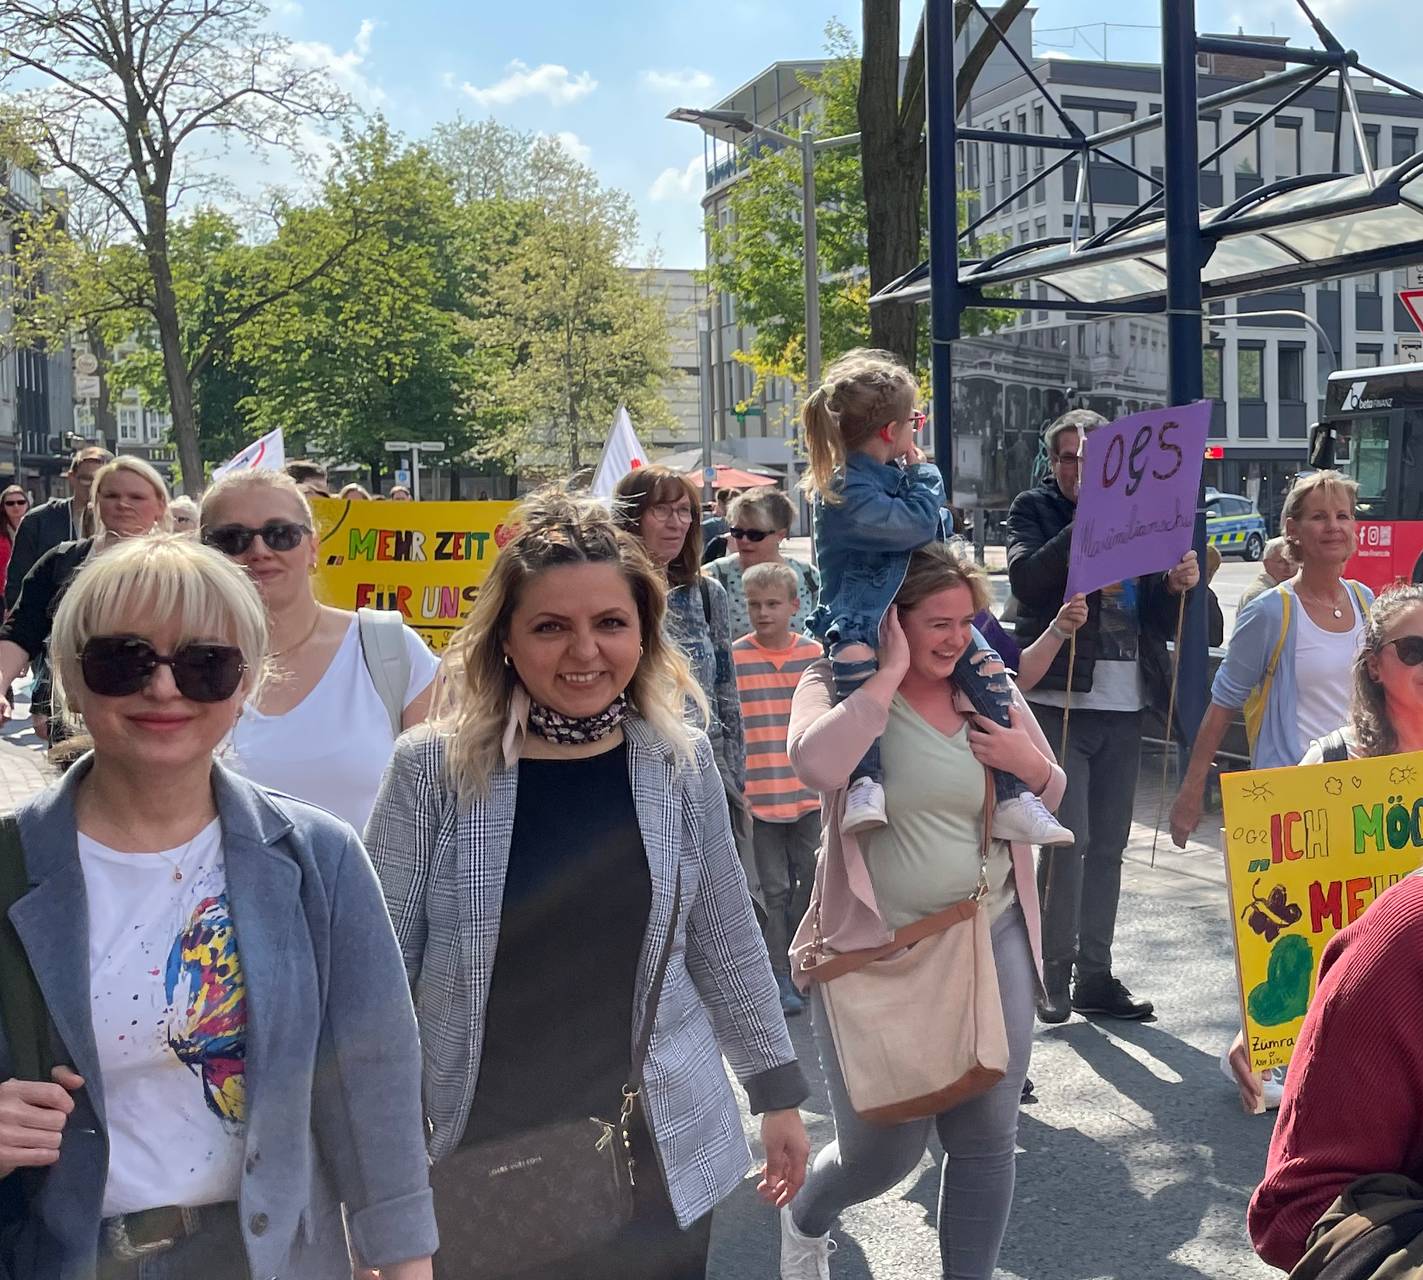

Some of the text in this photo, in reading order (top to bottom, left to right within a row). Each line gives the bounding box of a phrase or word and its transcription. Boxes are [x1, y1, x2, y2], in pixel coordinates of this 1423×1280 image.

[434, 531, 490, 561] ZEIT
[356, 583, 413, 618] FÜR
[1251, 1036, 1295, 1051] Zumra
